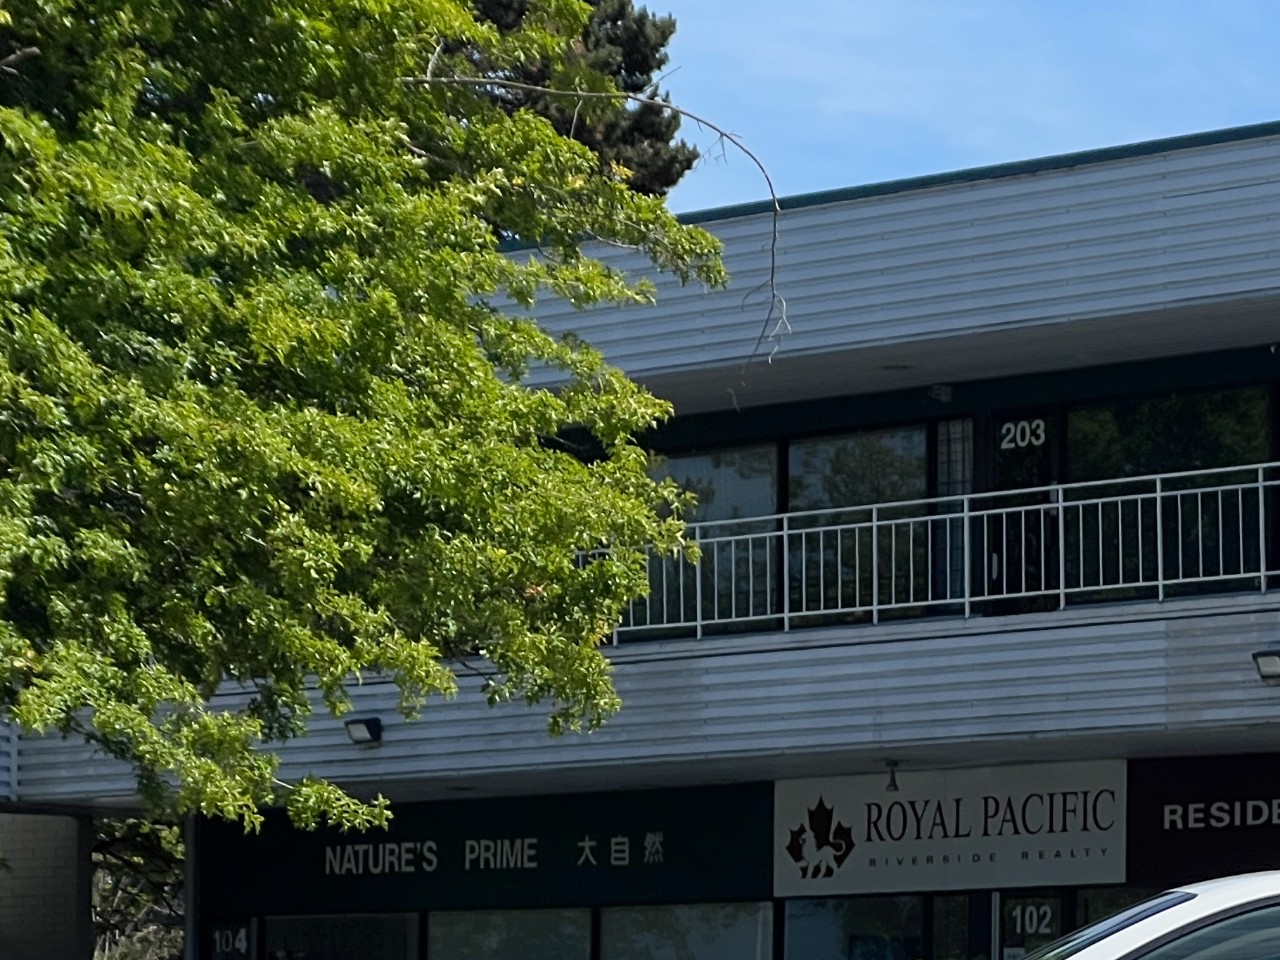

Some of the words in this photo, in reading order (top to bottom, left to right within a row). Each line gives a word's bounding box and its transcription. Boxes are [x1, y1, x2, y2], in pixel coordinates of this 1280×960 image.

[1000, 418, 1046, 450] 203
[865, 798, 972, 843] ROYAL
[981, 788, 1116, 837] PACIFIC
[325, 840, 438, 875] NATURE'S
[464, 838, 539, 870] PRIME
[577, 832, 664, 866] 大自然
[868, 852, 996, 867] RIVERSIDE
[1021, 847, 1109, 862] REALTY
[1012, 904, 1053, 935] 102
[213, 927, 248, 955] 104
